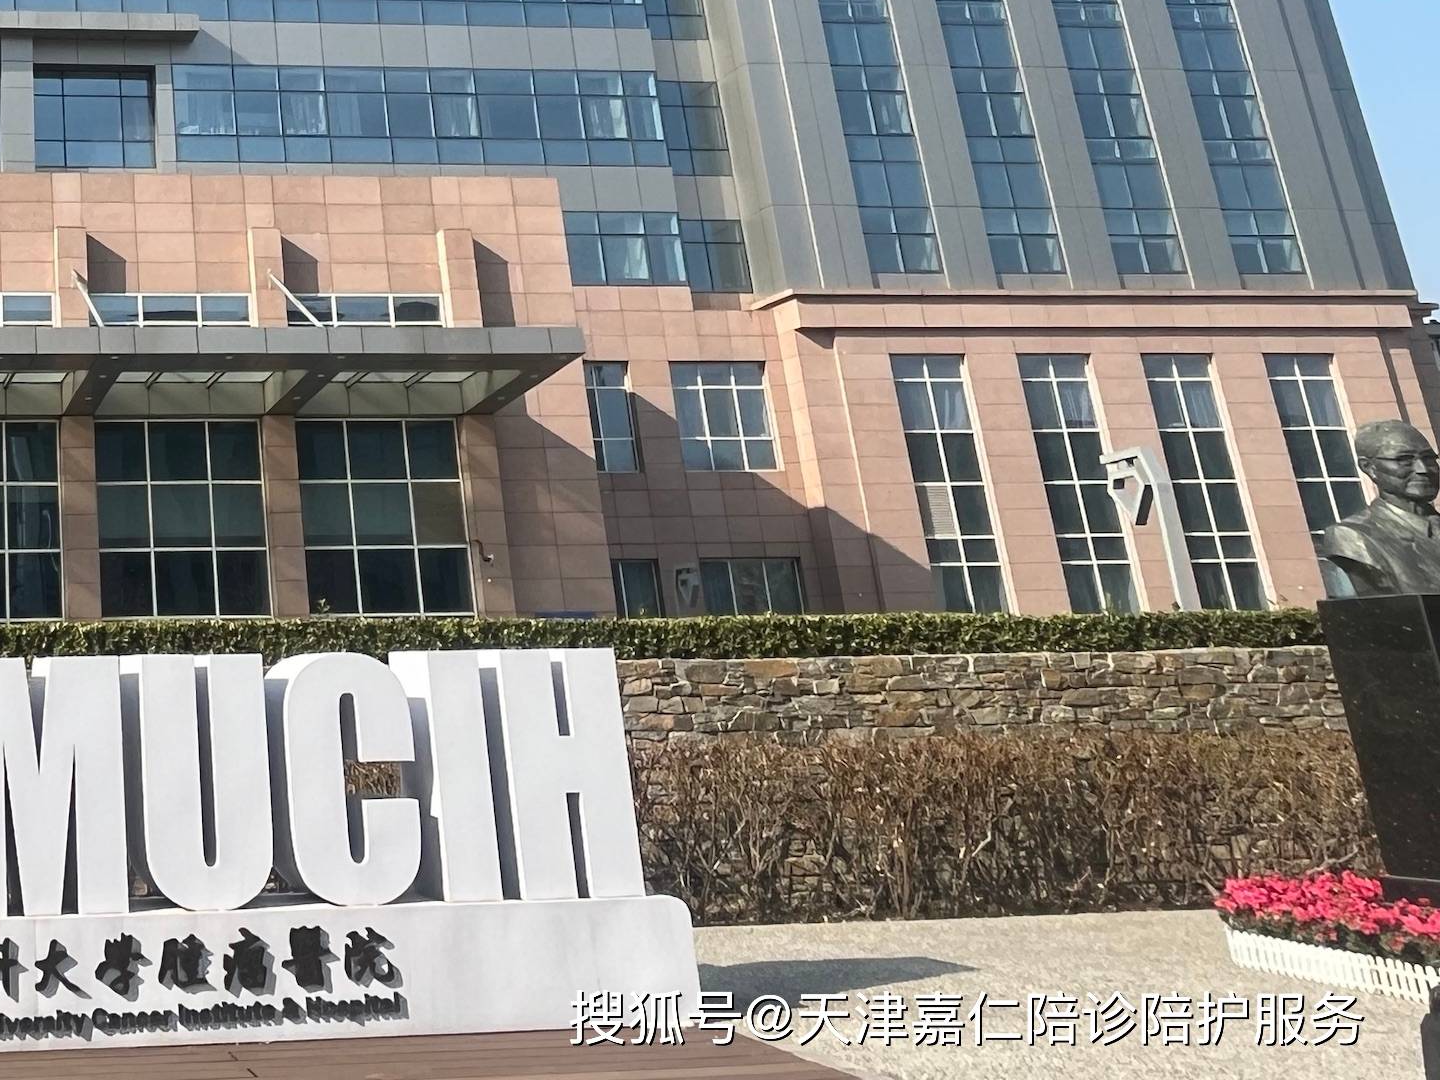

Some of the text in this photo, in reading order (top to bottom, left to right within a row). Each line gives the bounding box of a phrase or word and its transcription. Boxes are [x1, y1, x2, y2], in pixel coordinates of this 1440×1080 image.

[92, 1007, 179, 1036] Cancer
[177, 1001, 284, 1032] Institute
[283, 997, 308, 1024] &
[306, 991, 410, 1026] Hospital
